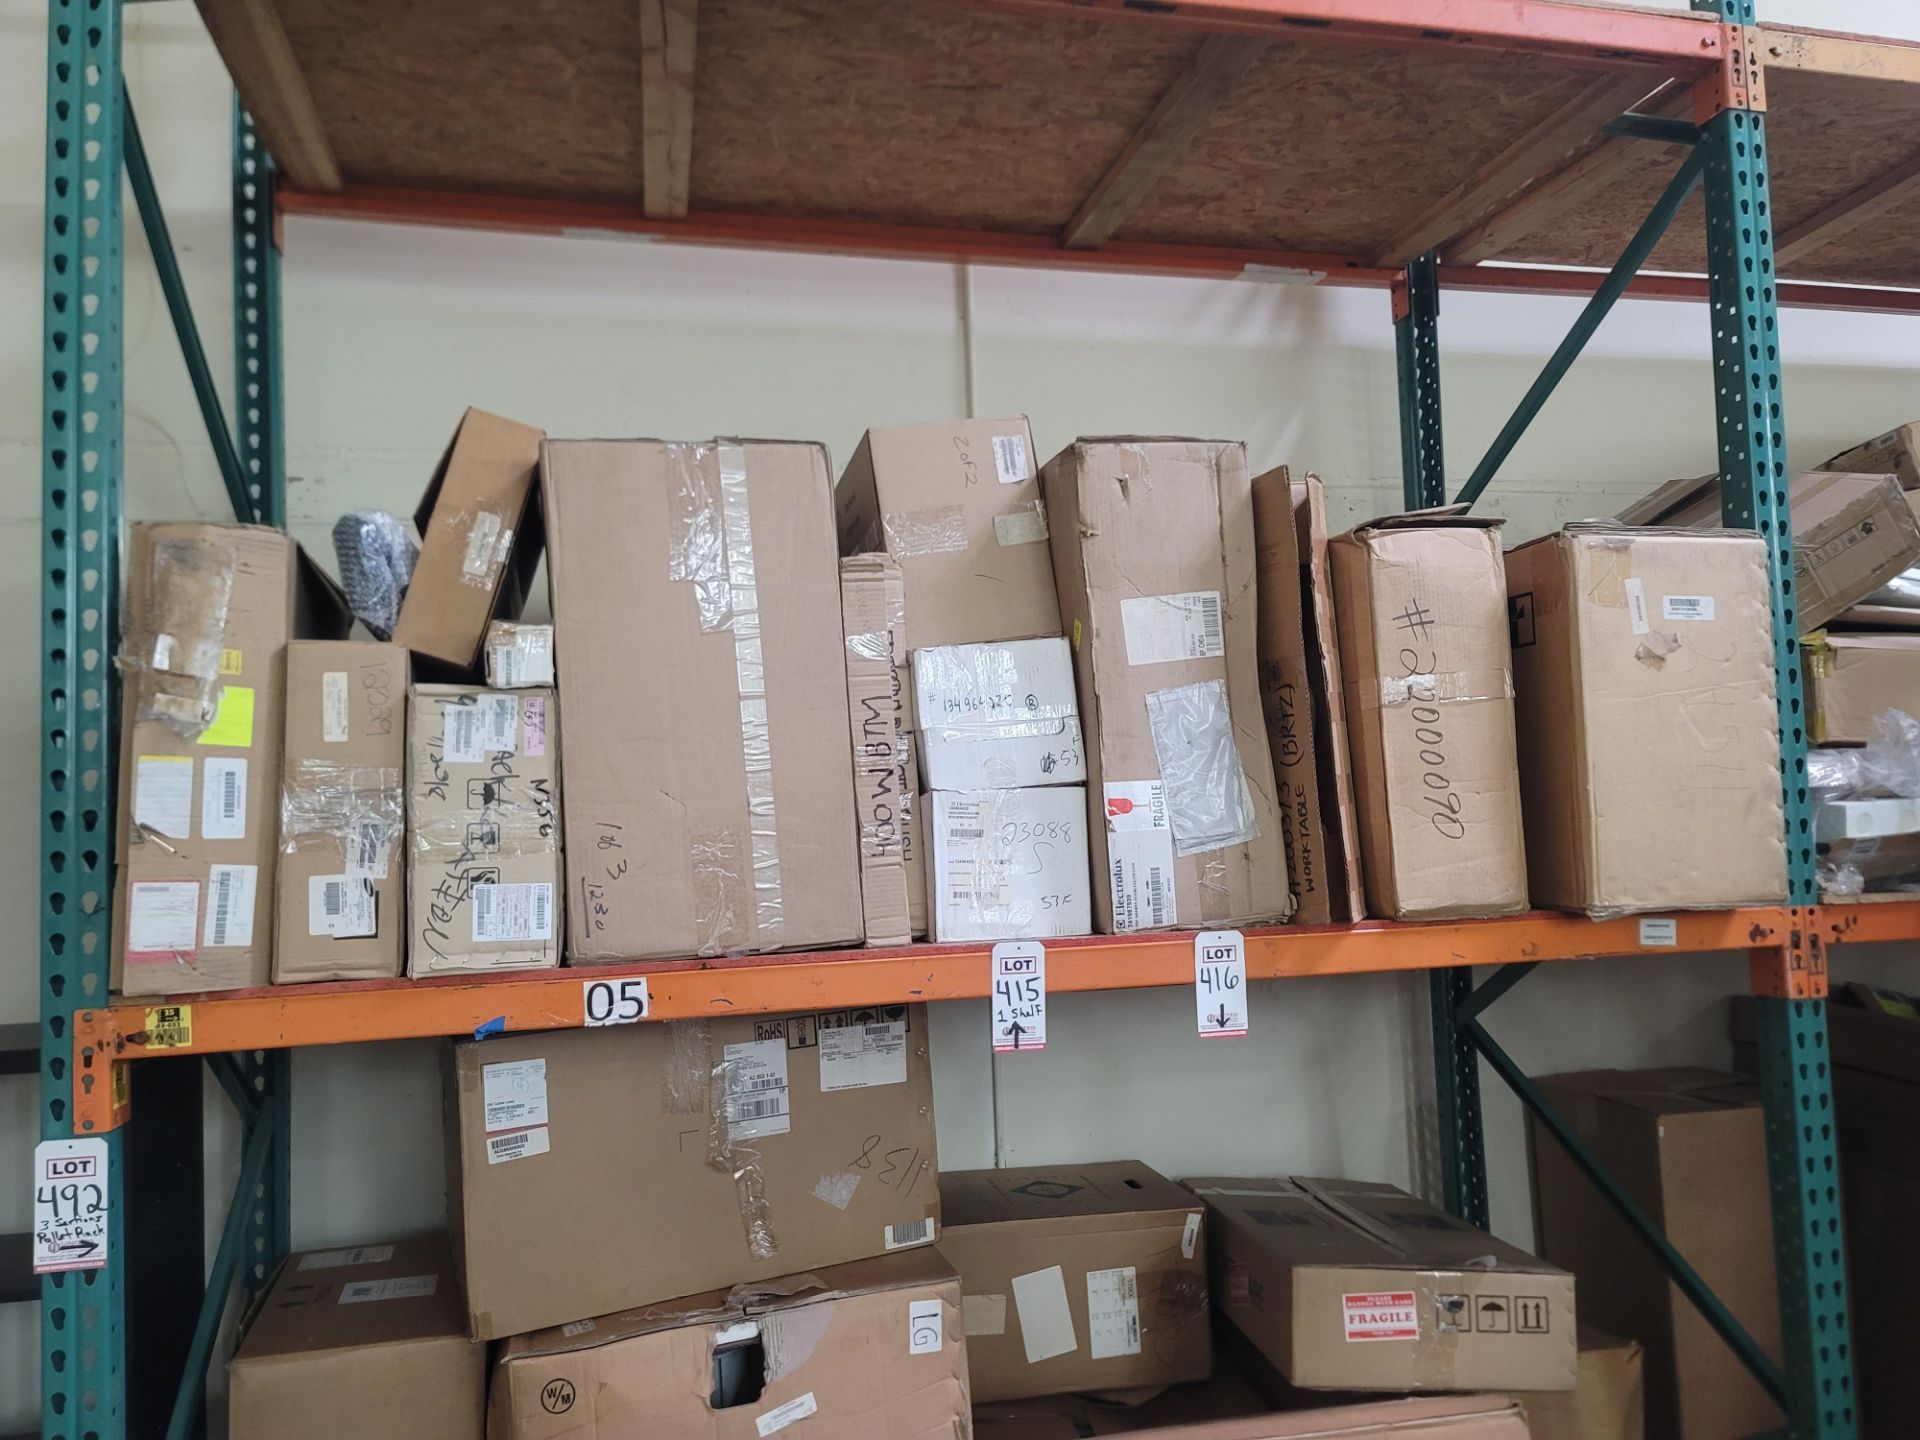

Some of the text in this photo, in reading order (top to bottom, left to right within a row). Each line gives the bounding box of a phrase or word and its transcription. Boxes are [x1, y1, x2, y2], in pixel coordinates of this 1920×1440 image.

[1151, 784, 1166, 828] FRAGILE
[1001, 820, 1072, 846] 23088
[1114, 858, 1126, 917] Electrolux
[1004, 960, 1033, 971] LOT
[1206, 948, 1233, 960] LOT
[996, 976, 1042, 1006] 415
[1200, 966, 1239, 994] 416
[586, 980, 644, 1021] 05
[757, 1022, 783, 1041] RoHS
[52, 1160, 91, 1175] LOT
[37, 1184, 108, 1218] 492
[40, 1220, 50, 1231] 3
[912, 1313, 939, 1346] LG
[1349, 1312, 1413, 1324] FRAGILE
